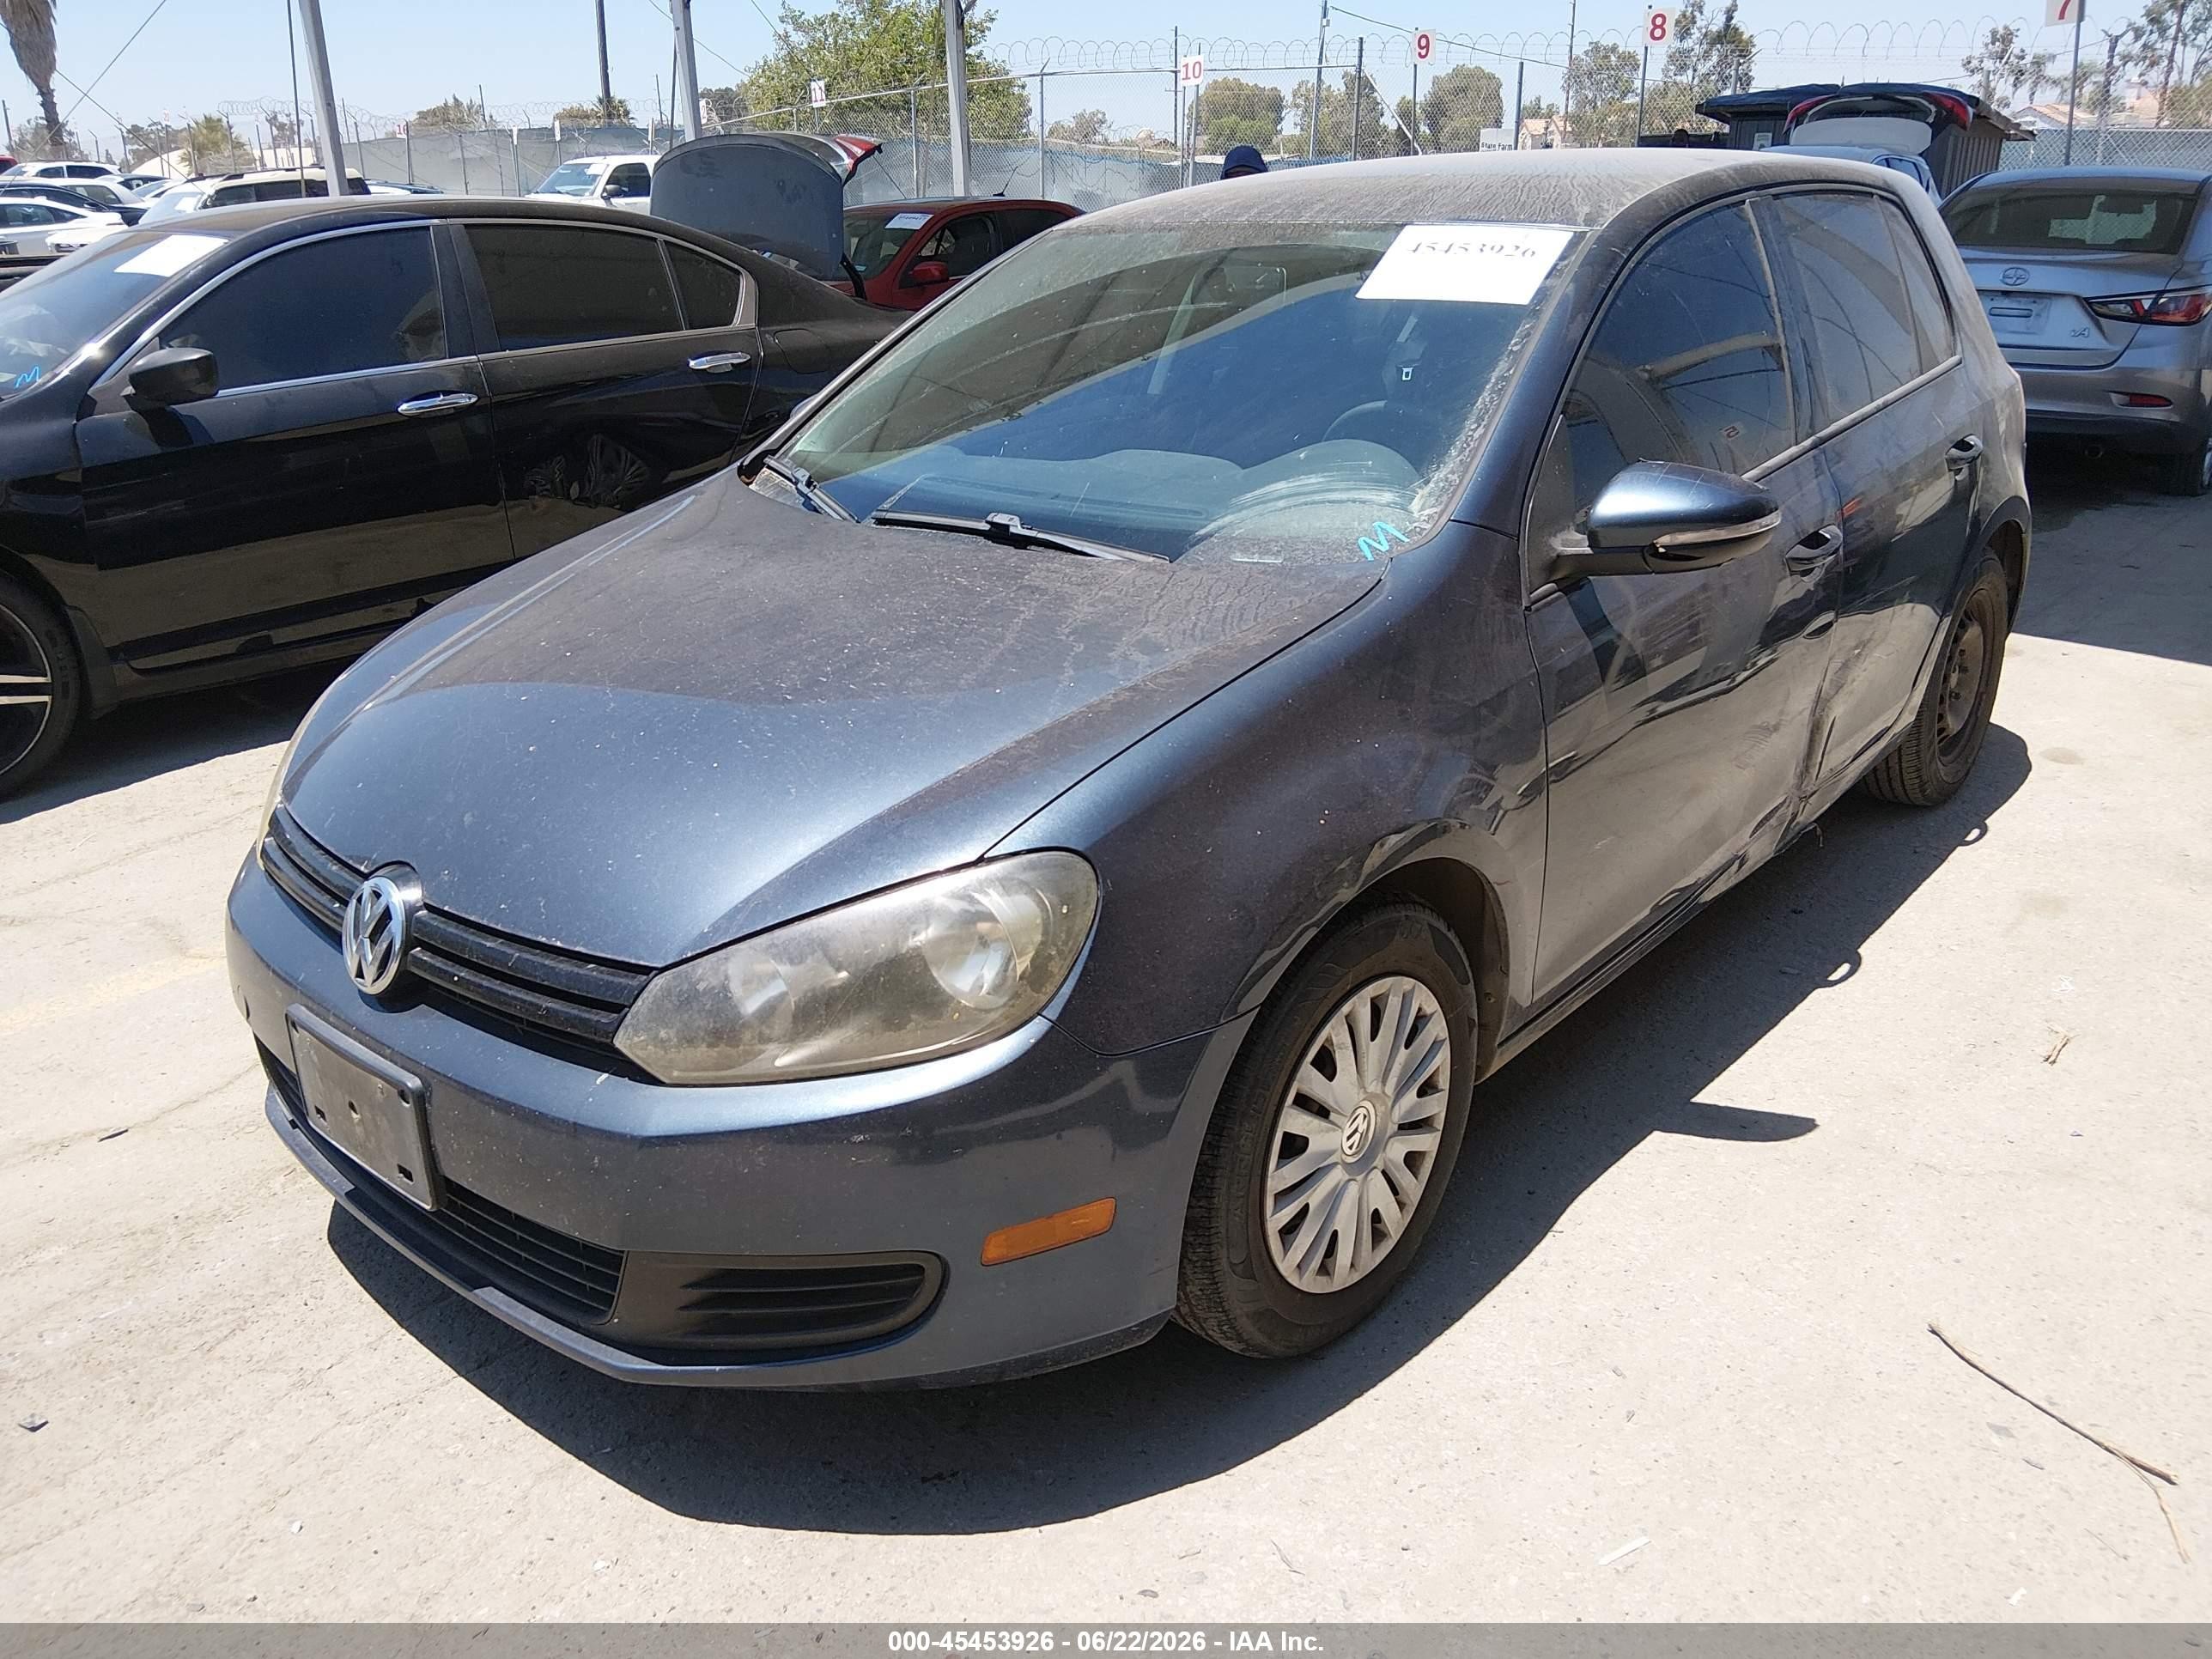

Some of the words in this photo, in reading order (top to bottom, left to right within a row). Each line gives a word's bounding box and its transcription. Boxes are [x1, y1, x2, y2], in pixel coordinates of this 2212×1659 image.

[1650, 13, 1667, 40] 8
[1418, 34, 1430, 59] 9
[1182, 61, 1202, 81] 10
[812, 87, 825, 102] 11
[1358, 521, 1410, 561] M
